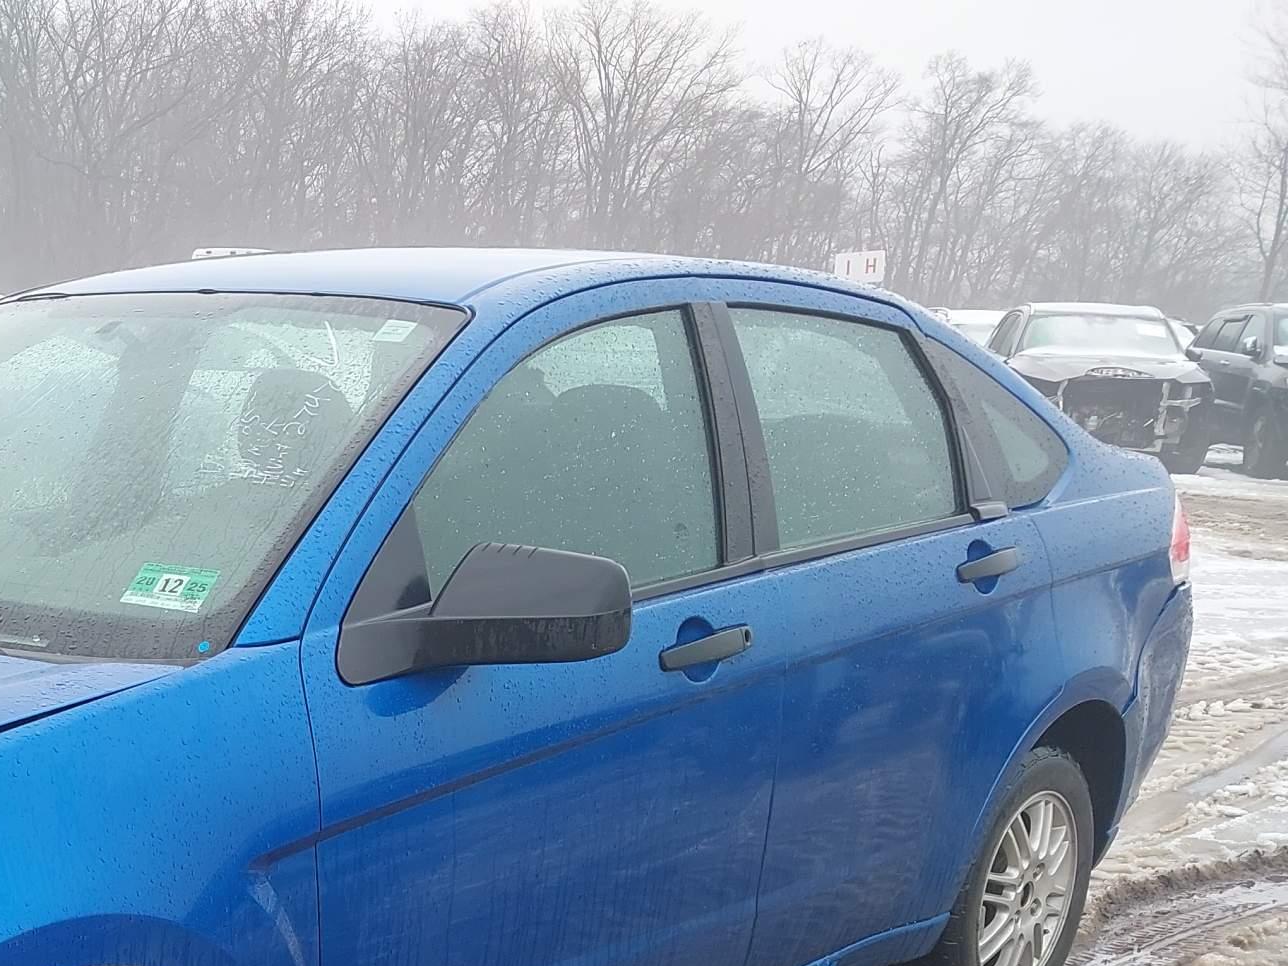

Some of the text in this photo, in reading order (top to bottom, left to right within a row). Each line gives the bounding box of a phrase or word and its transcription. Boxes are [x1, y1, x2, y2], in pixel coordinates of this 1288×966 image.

[864, 257, 878, 275] H
[135, 575, 209, 594] 20 12 25
